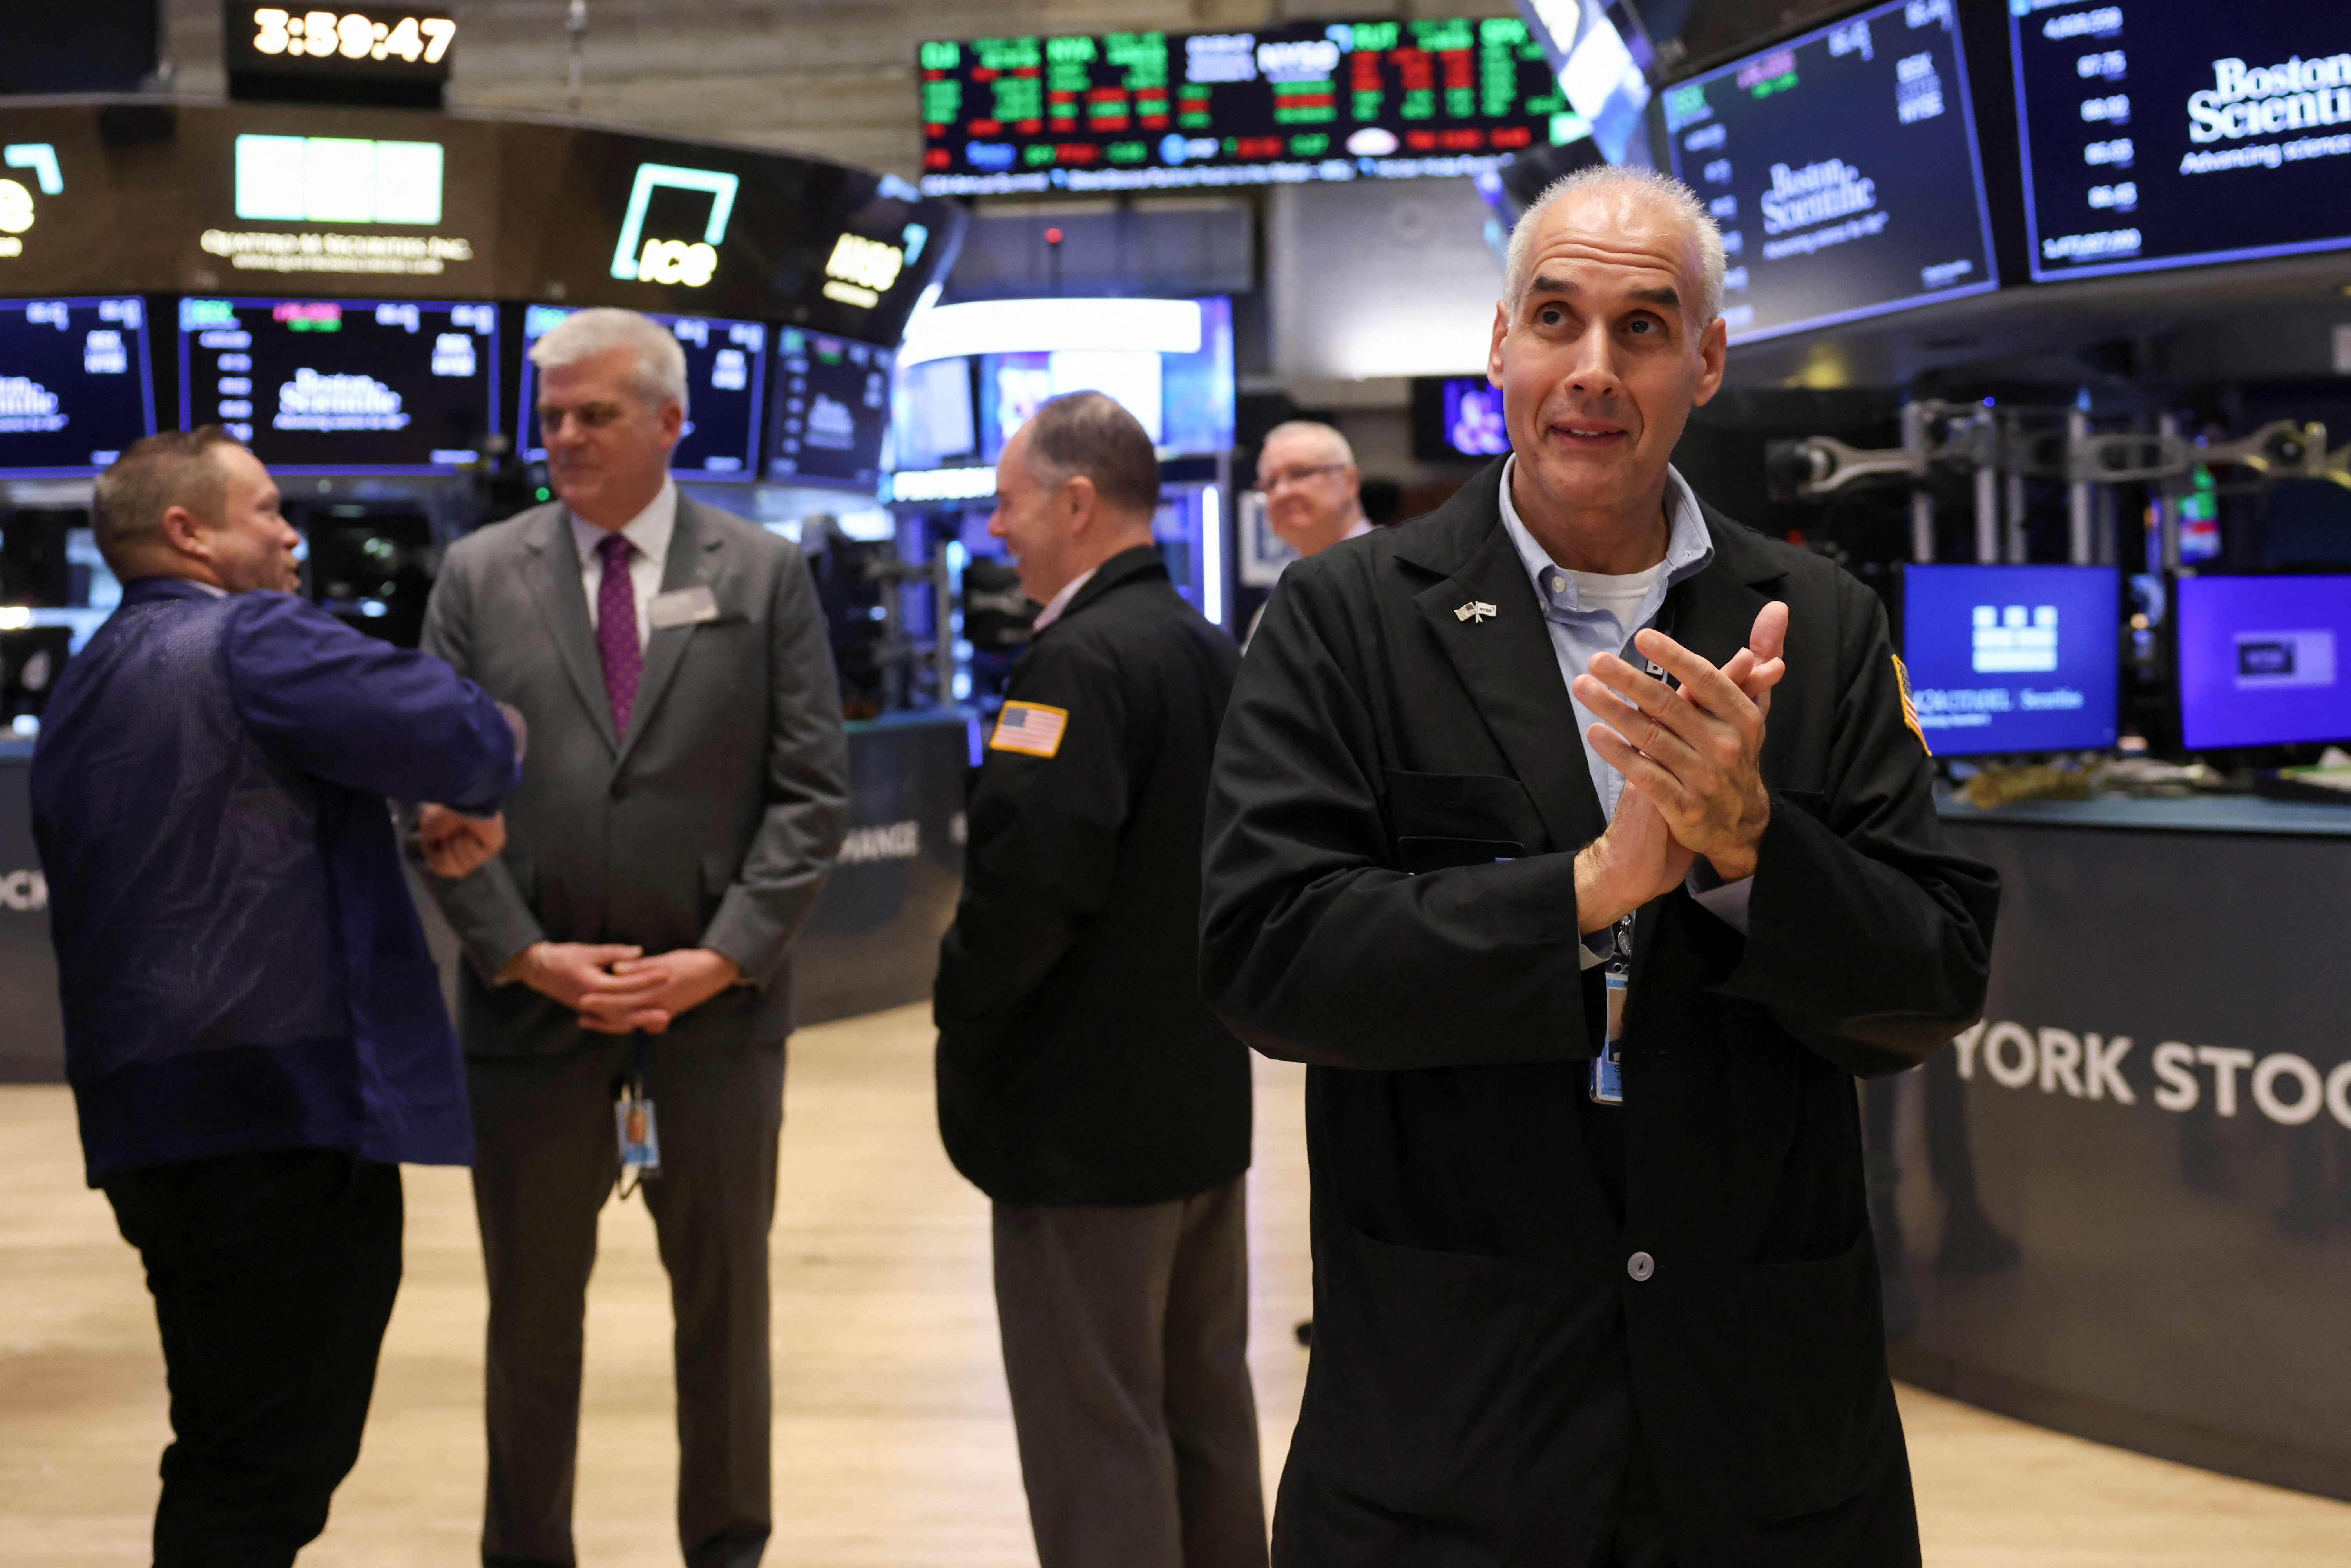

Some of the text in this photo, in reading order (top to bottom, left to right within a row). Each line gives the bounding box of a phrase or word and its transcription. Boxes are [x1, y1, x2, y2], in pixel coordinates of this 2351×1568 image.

[253, 8, 456, 63] 3:59:47
[2212, 53, 2351, 103] Boston
[2188, 87, 2351, 143] Scienti
[1770, 158, 1844, 198] Boston
[2180, 144, 2282, 176] Advancing
[1761, 165, 1876, 234] Scientific
[1953, 1019, 2137, 1106] YORK
